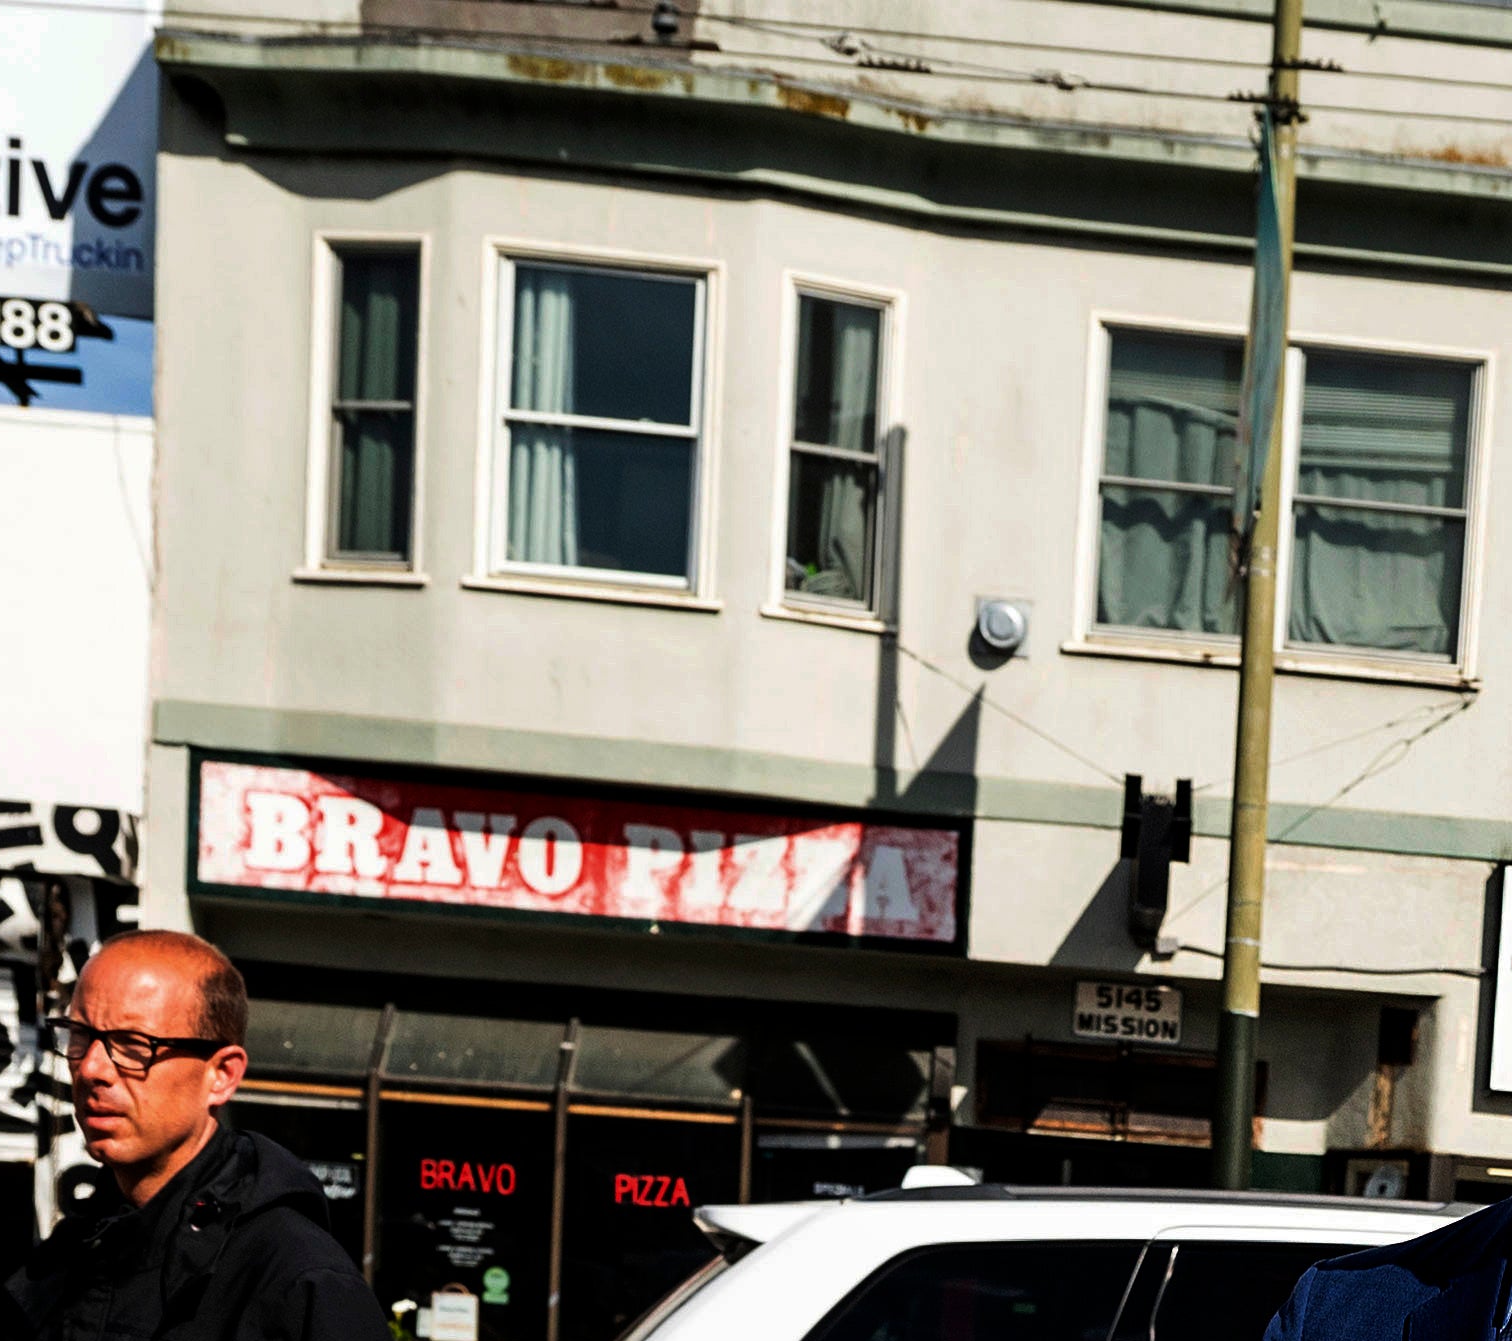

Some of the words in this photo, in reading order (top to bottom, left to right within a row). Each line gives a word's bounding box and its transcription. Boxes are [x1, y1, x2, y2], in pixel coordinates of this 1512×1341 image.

[245, 790, 584, 896] BRAVO
[1096, 986, 1162, 1013] 5145
[1078, 1014, 1178, 1040] MISSION
[420, 1158, 517, 1196] BRAVO
[614, 1173, 691, 1207] PIZZA
